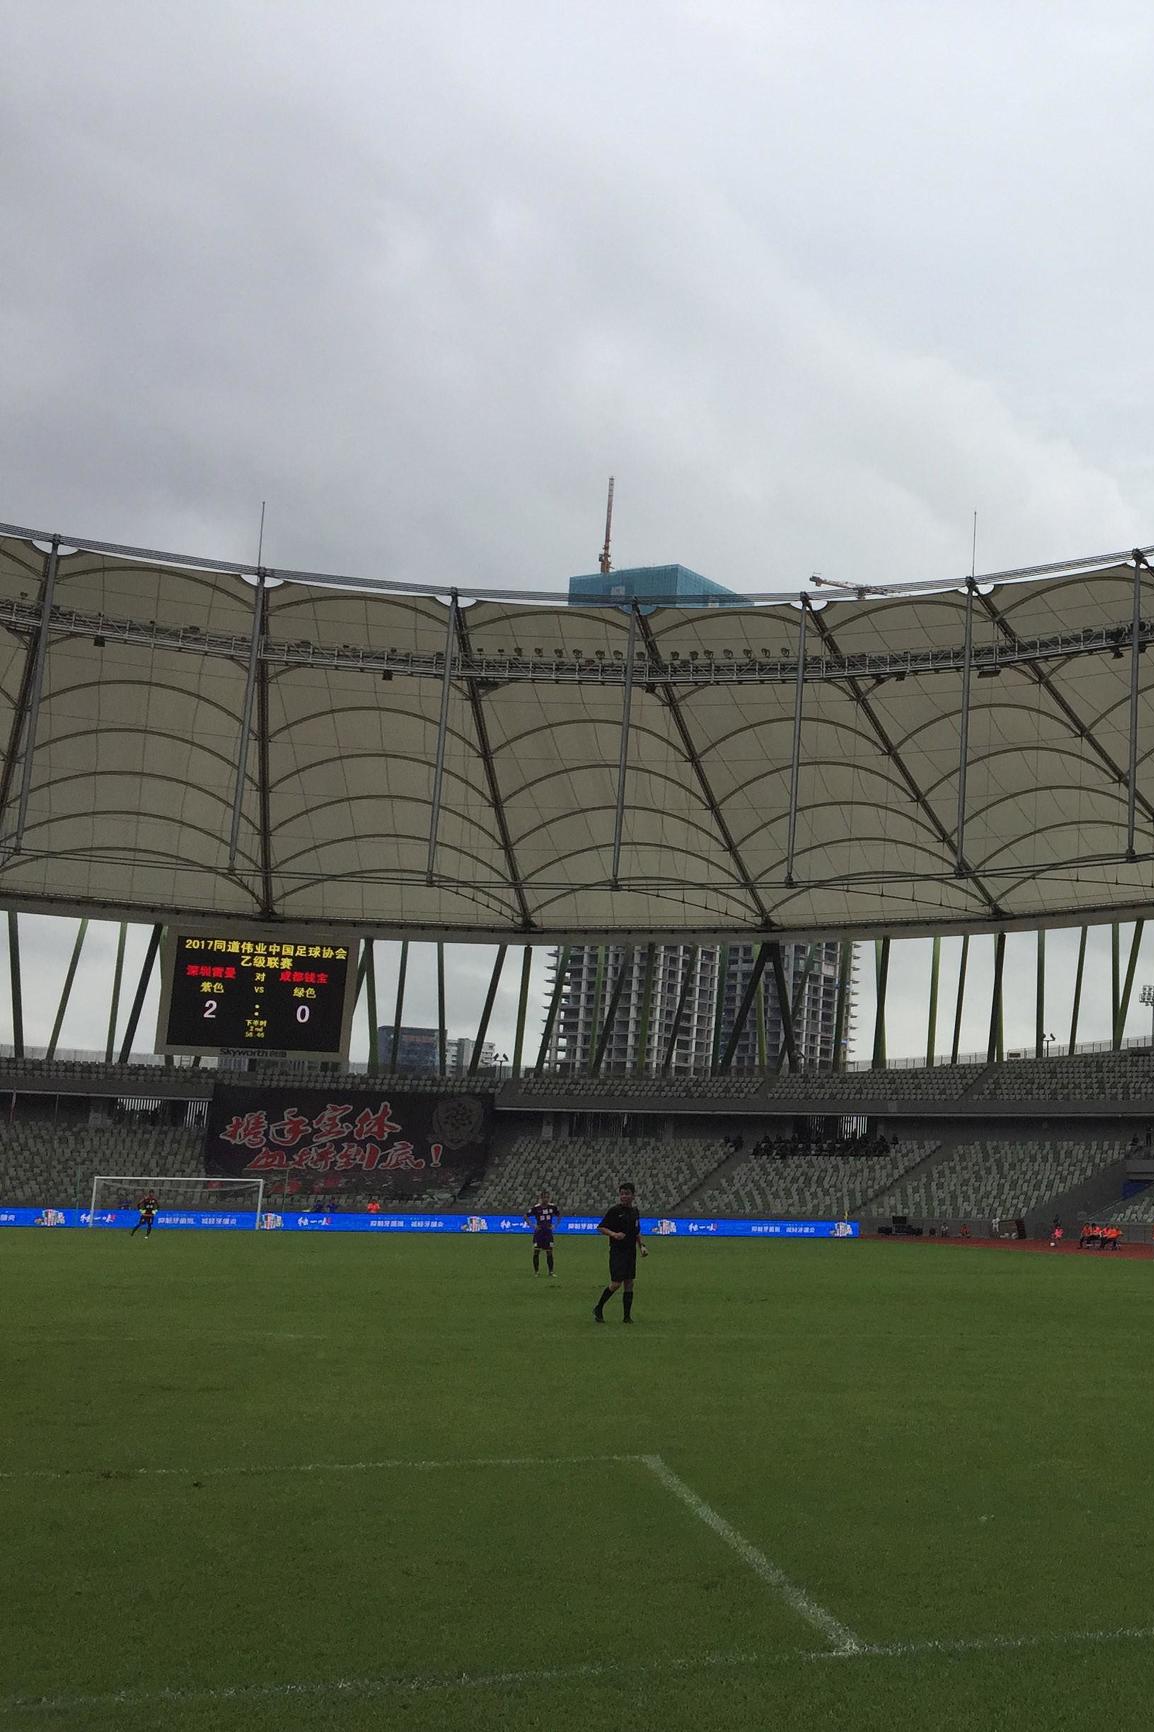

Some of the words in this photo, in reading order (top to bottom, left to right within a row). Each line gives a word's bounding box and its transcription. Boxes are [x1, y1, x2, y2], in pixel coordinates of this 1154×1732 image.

[185, 939, 347, 960] 2017同道伟业中国足球协会
[240, 955, 293, 970] 乙级联赛
[254, 972, 266, 982] 对
[200, 982, 224, 994] 紫色
[293, 987, 316, 998] 绿色
[203, 1000, 217, 1018] 2
[296, 1005, 310, 1023] 0
